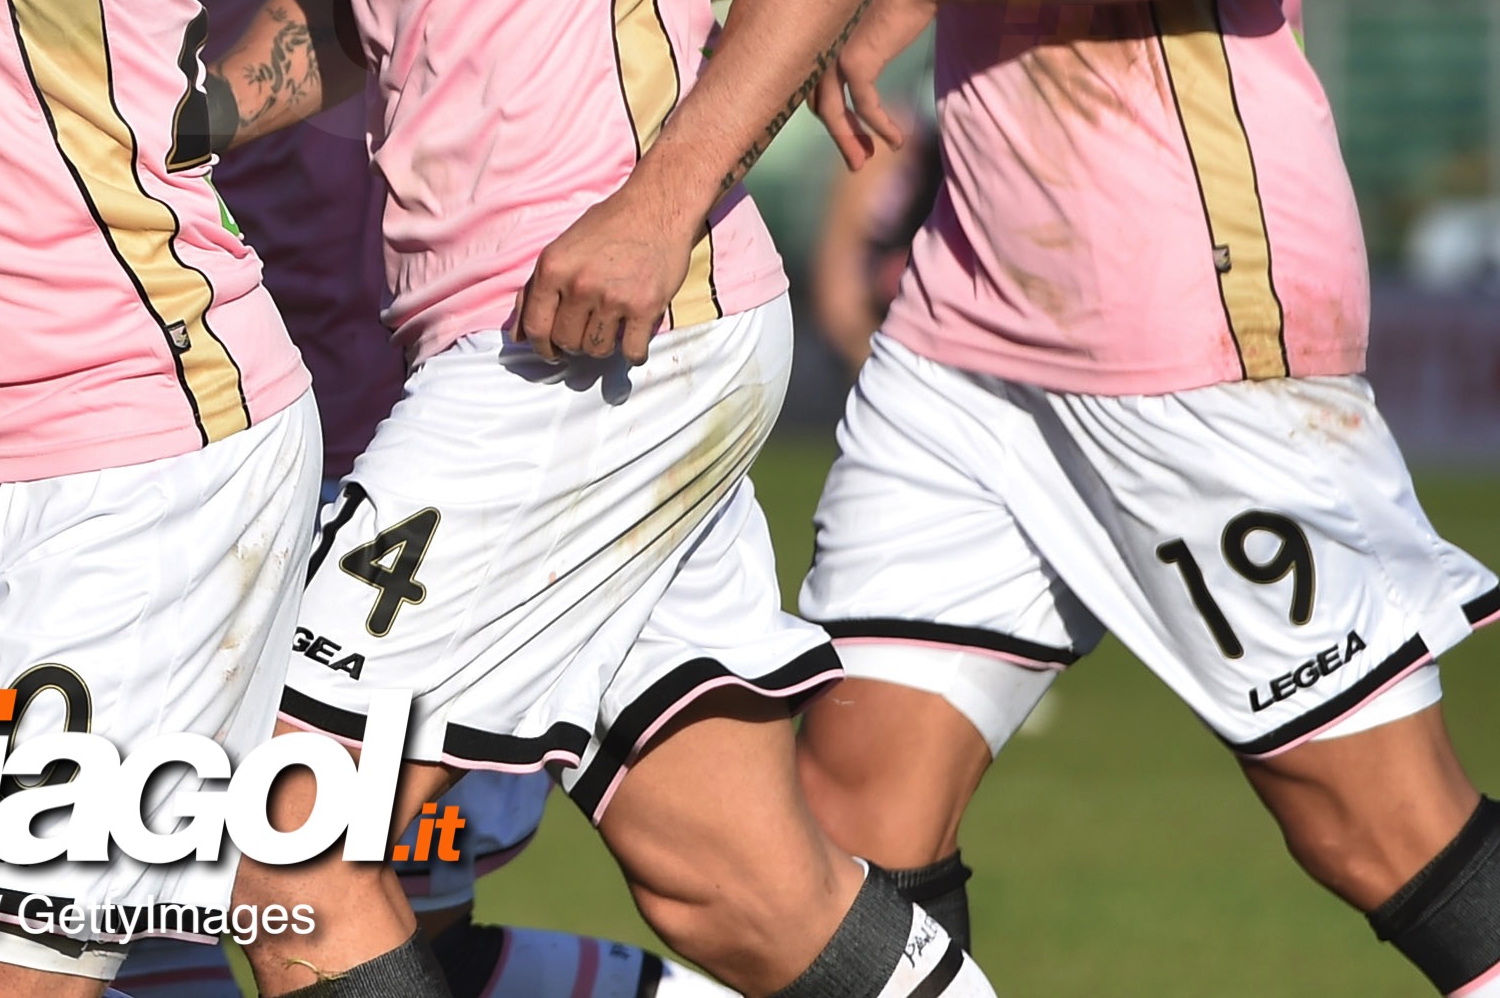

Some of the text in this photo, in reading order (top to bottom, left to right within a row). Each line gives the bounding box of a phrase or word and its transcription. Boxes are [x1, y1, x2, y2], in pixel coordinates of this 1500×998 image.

[1155, 508, 1318, 661] 19
[291, 625, 367, 682] GEA
[1247, 628, 1367, 714] LEGEA
